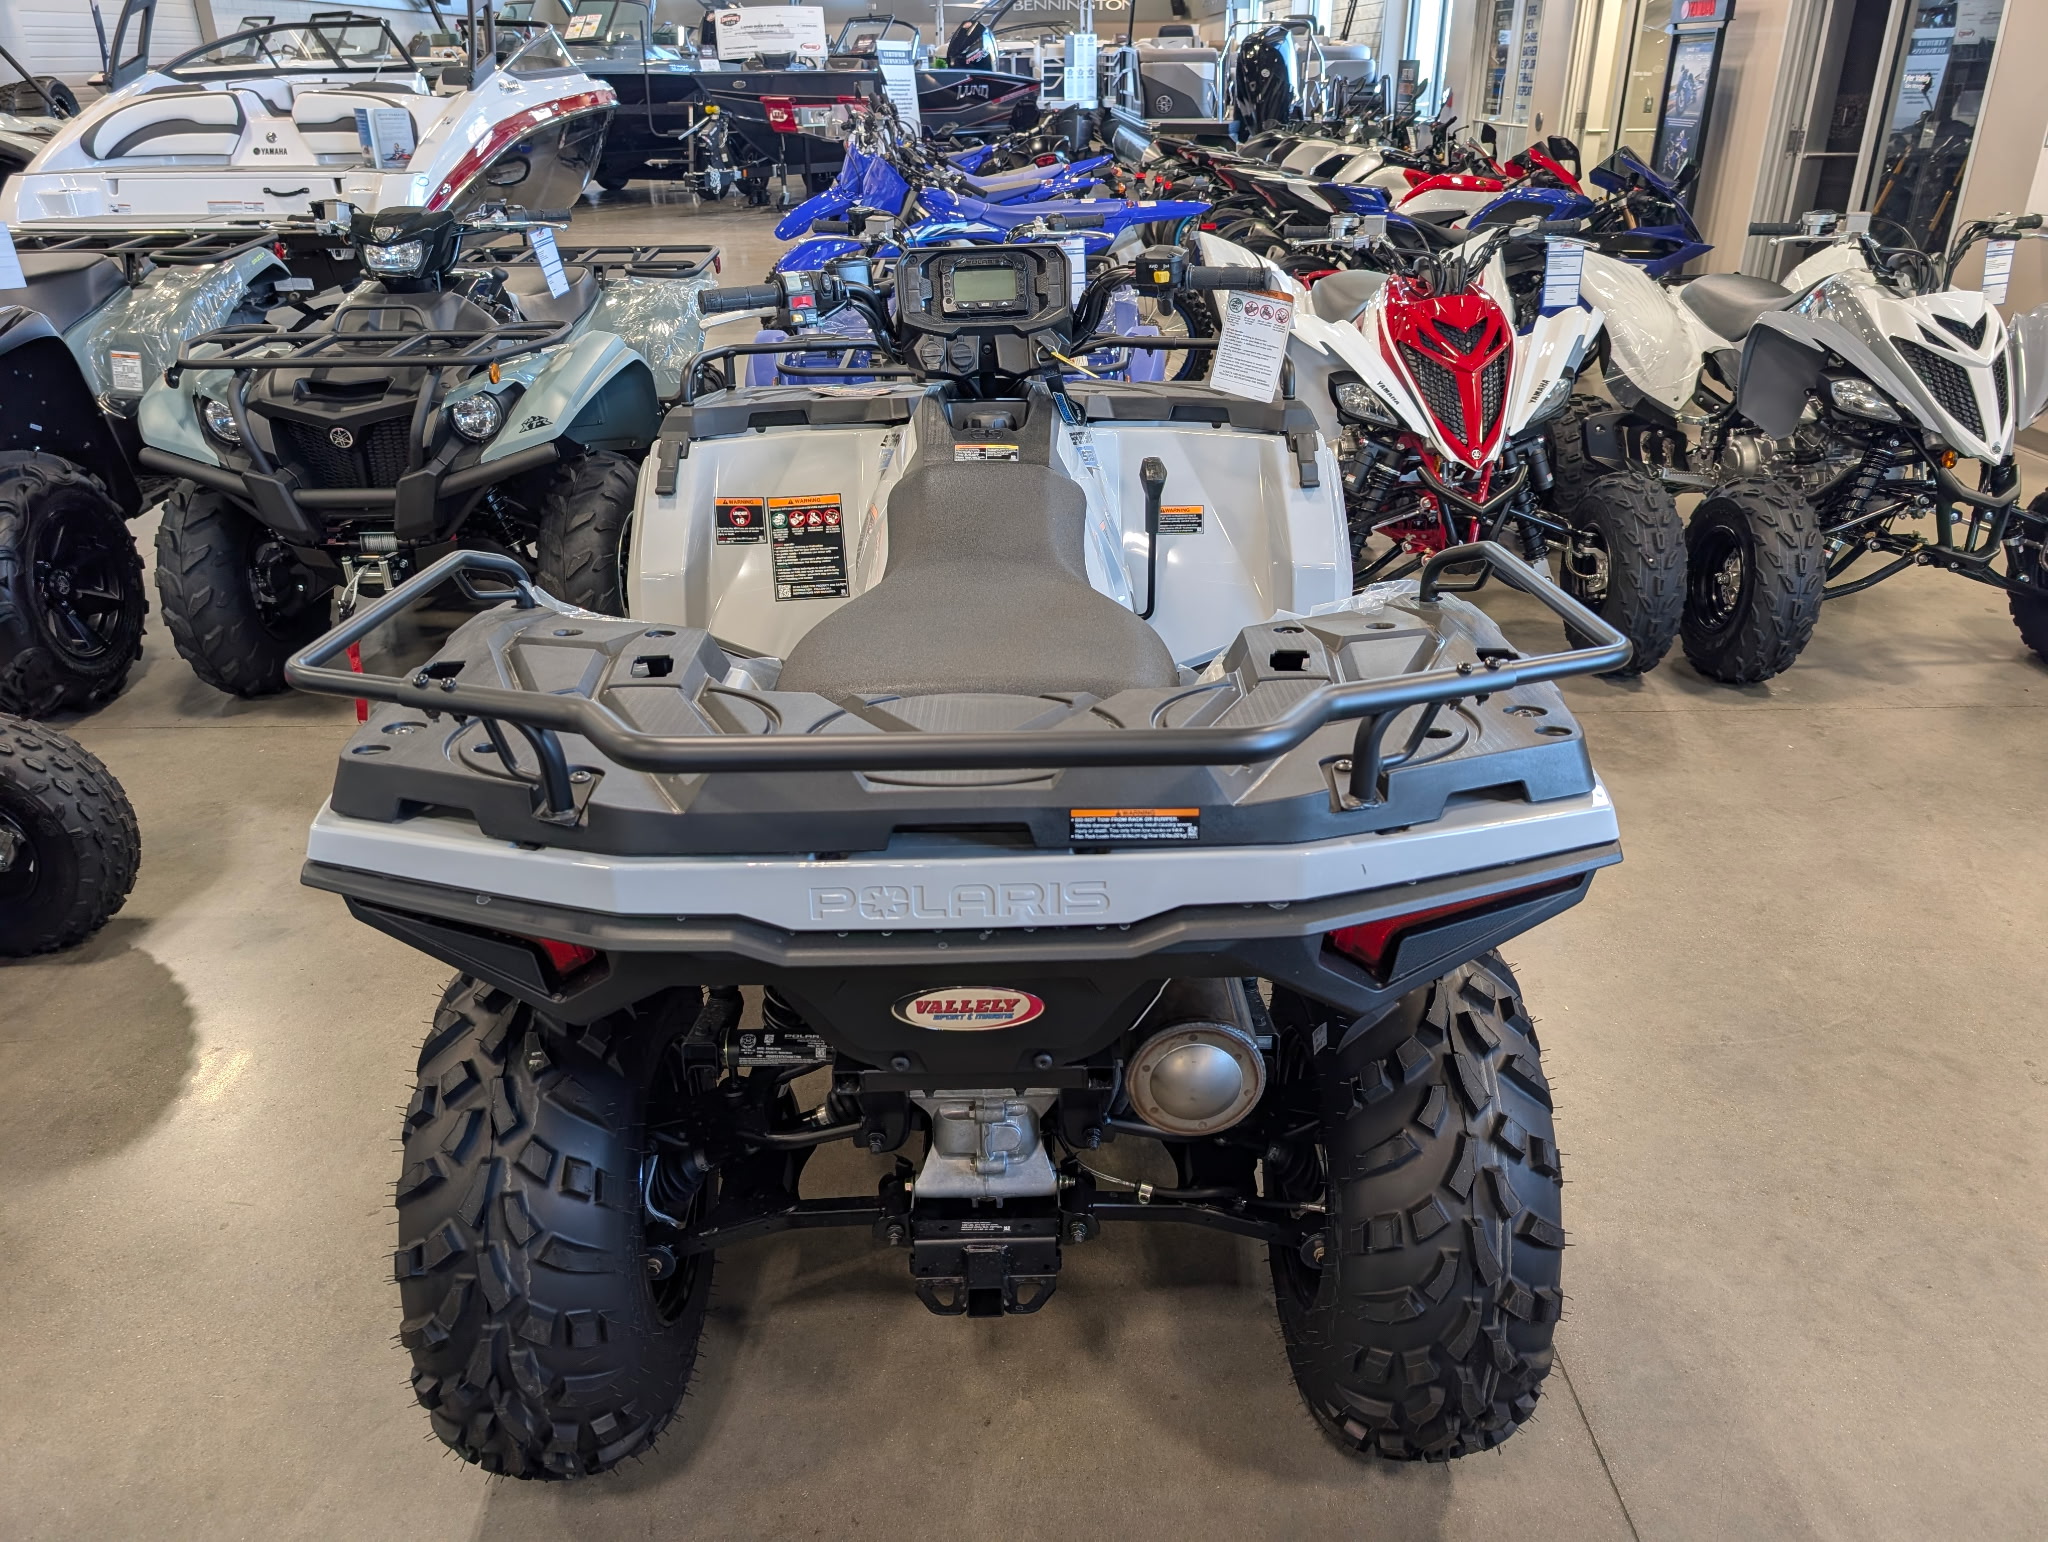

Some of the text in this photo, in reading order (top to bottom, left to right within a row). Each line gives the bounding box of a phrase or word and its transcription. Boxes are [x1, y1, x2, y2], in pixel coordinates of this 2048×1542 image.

[956, 84, 989, 100] LUND
[1376, 380, 1400, 405] YAMAHA
[1529, 379, 1550, 404] YAMAHA
[736, 517, 745, 525] 16
[808, 880, 1110, 921] POLARIS
[915, 998, 1021, 1015] VALLELY
[932, 1013, 965, 1021] SPORT
[974, 1012, 1014, 1020] MARINE
